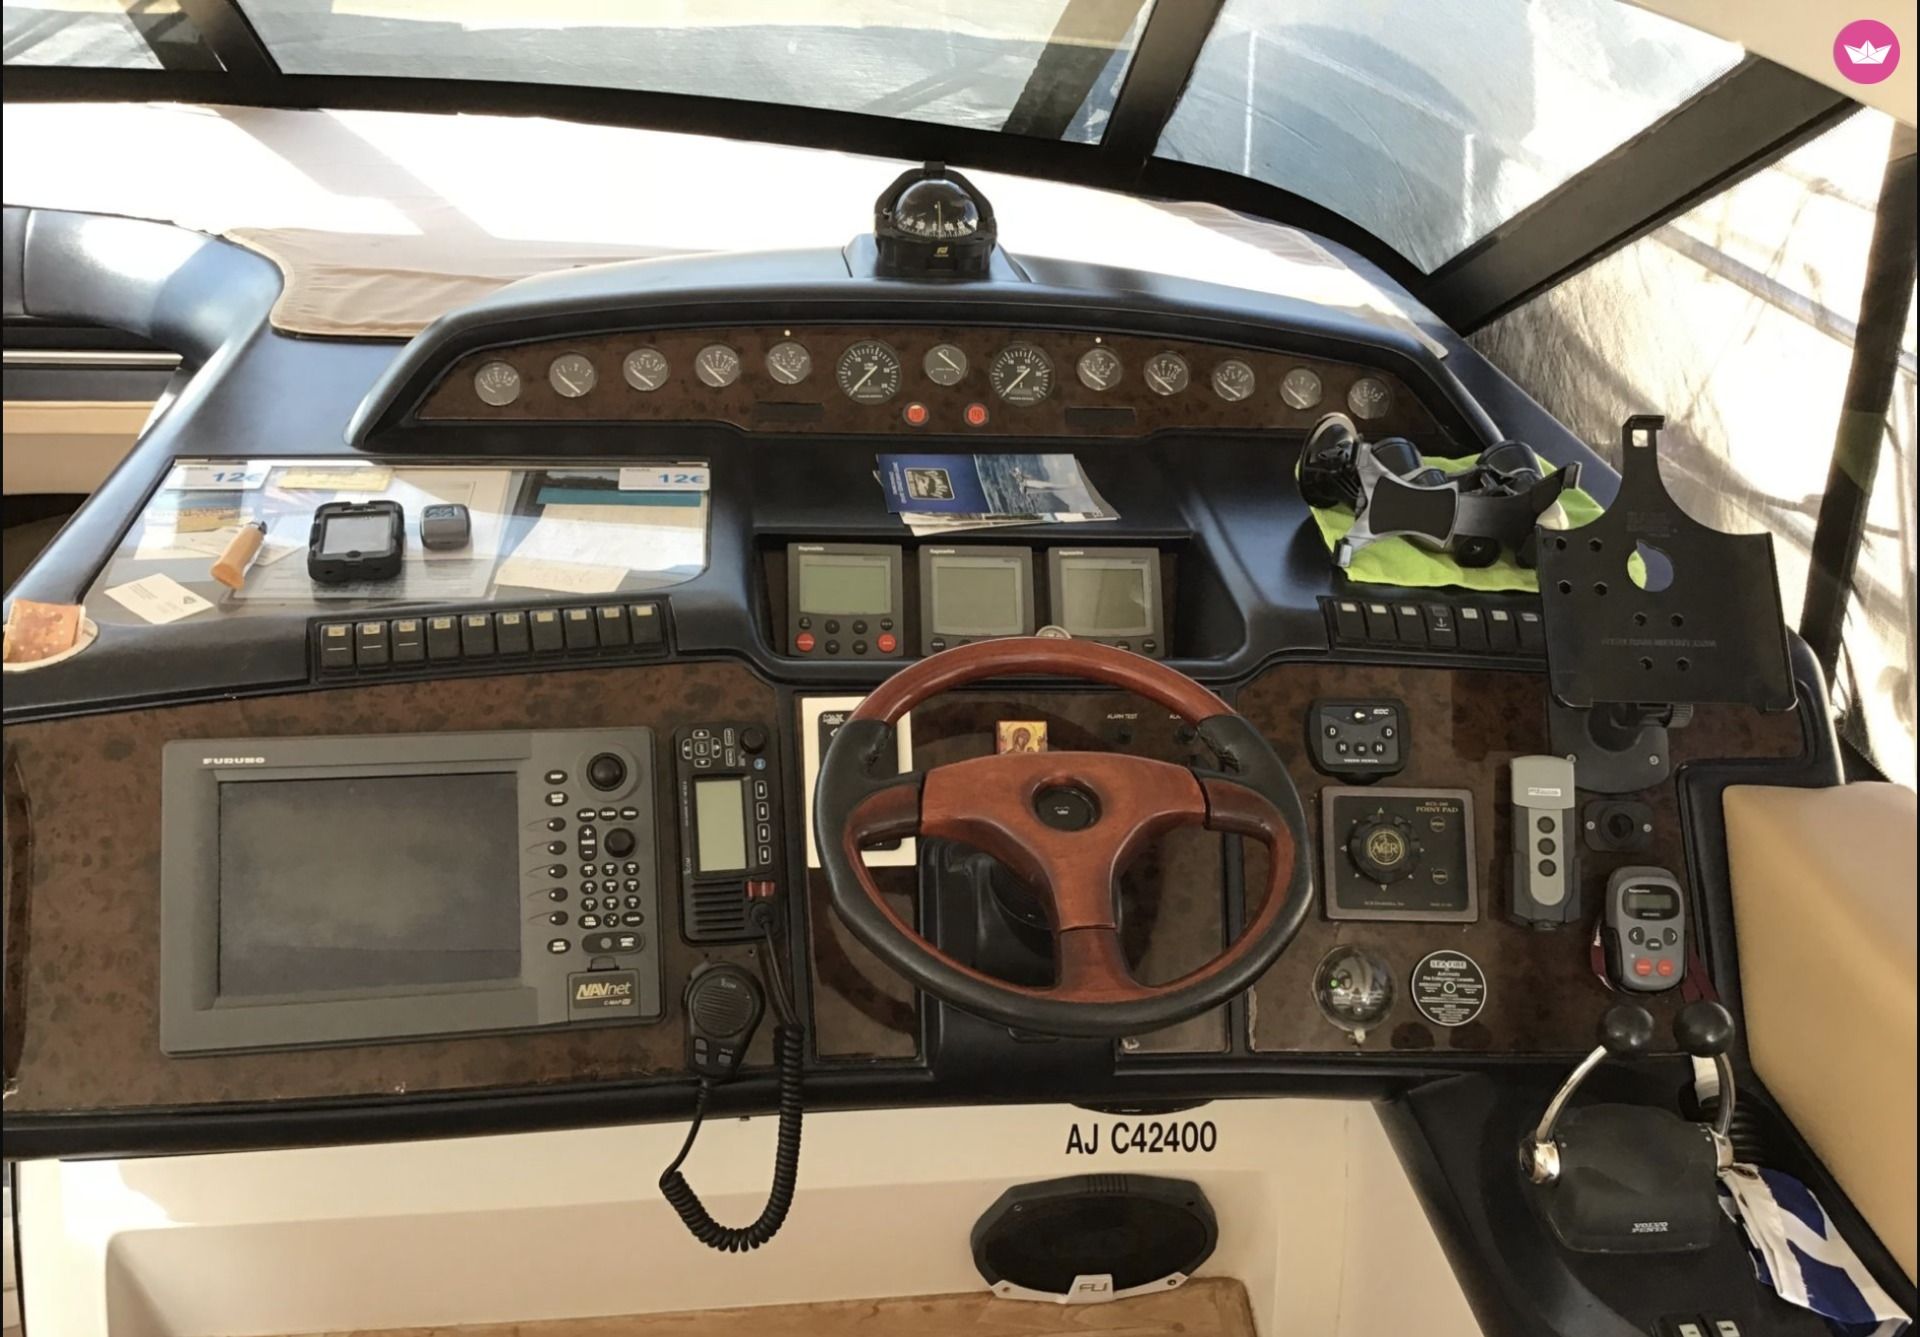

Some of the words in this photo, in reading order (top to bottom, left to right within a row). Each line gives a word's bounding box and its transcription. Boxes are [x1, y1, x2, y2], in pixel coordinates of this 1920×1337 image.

[659, 473, 705, 484] 12€
[1330, 727, 1336, 735] D
[1386, 728, 1393, 736] D
[1340, 743, 1346, 751] N
[1376, 744, 1383, 752] N
[203, 757, 265, 765] FURUNO
[576, 982, 632, 1000] NAVnet
[1065, 1123, 1099, 1155] AJ
[1111, 1120, 1217, 1154] C42400
